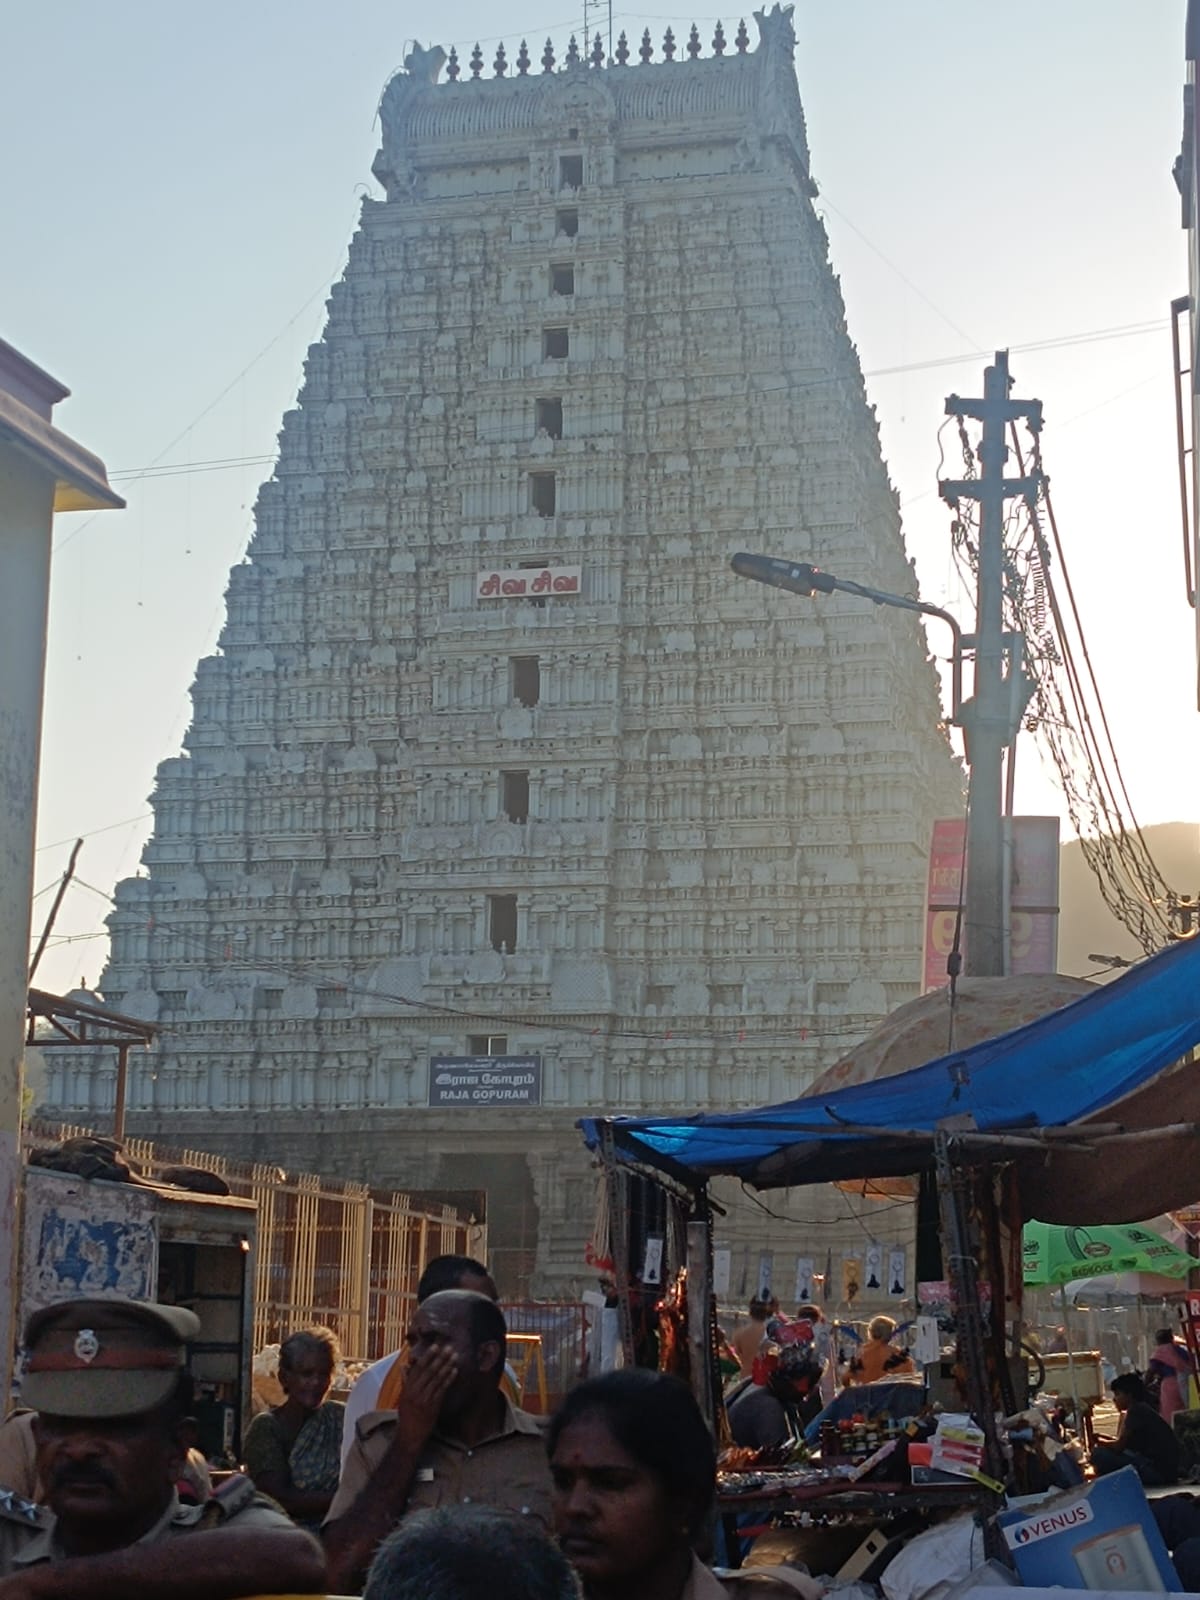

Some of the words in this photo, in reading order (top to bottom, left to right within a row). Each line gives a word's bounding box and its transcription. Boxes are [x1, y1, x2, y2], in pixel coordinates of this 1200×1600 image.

[440, 1090, 469, 1100] RAJA
[472, 1090, 529, 1099] GOPURAM
[1029, 1506, 1088, 1537] VENUS
